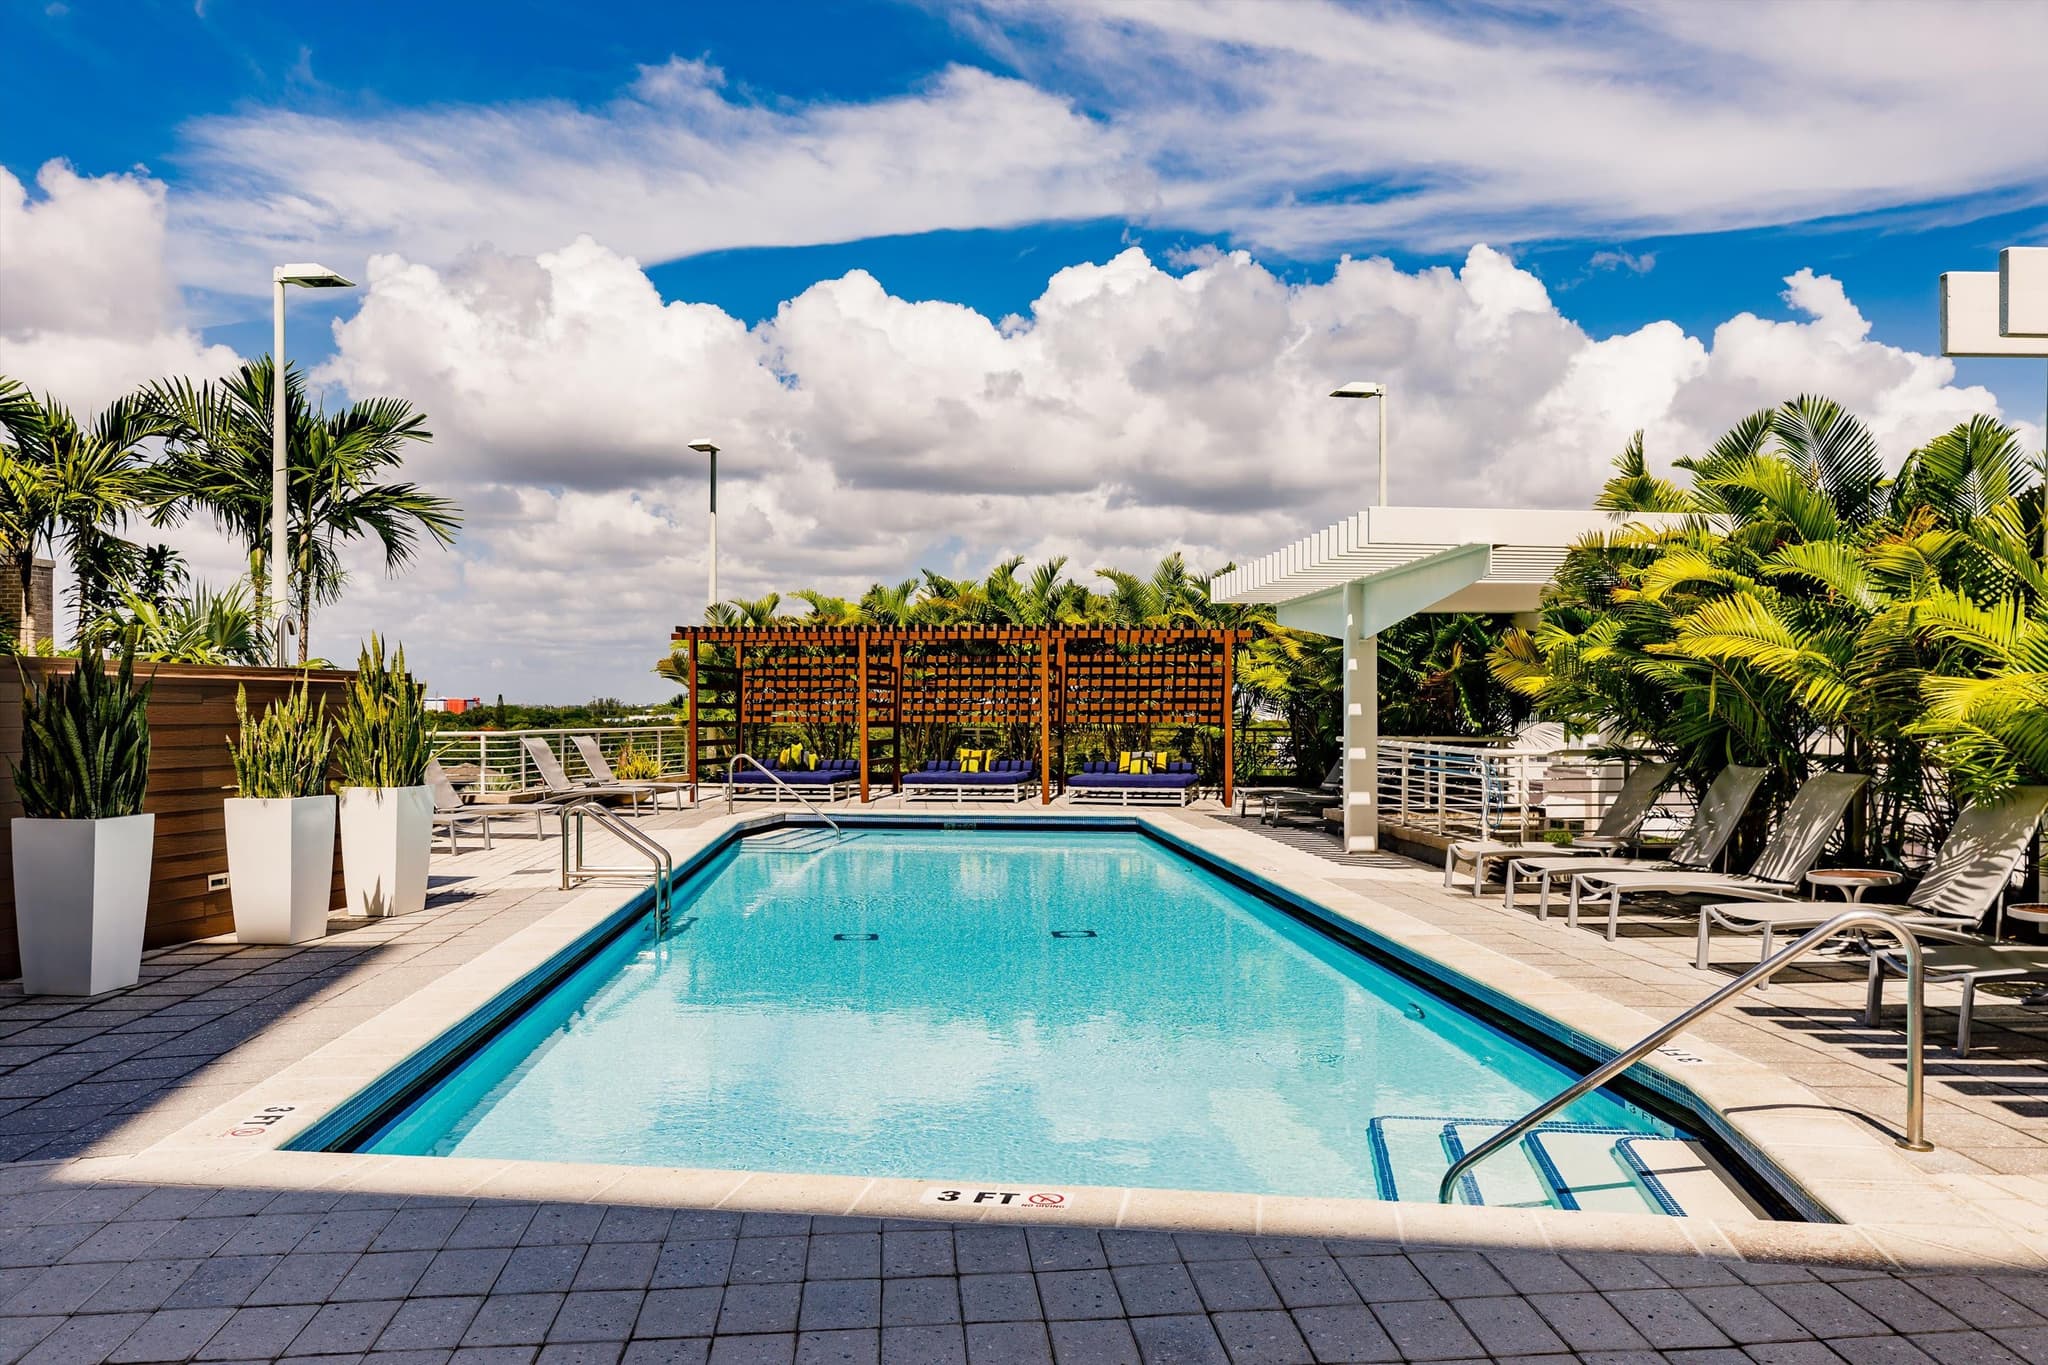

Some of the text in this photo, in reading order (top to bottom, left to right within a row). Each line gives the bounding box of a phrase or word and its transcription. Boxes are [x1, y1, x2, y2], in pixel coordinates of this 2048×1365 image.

[243, 1115, 285, 1126] FT
[937, 1190, 1021, 1205] 3 FT
